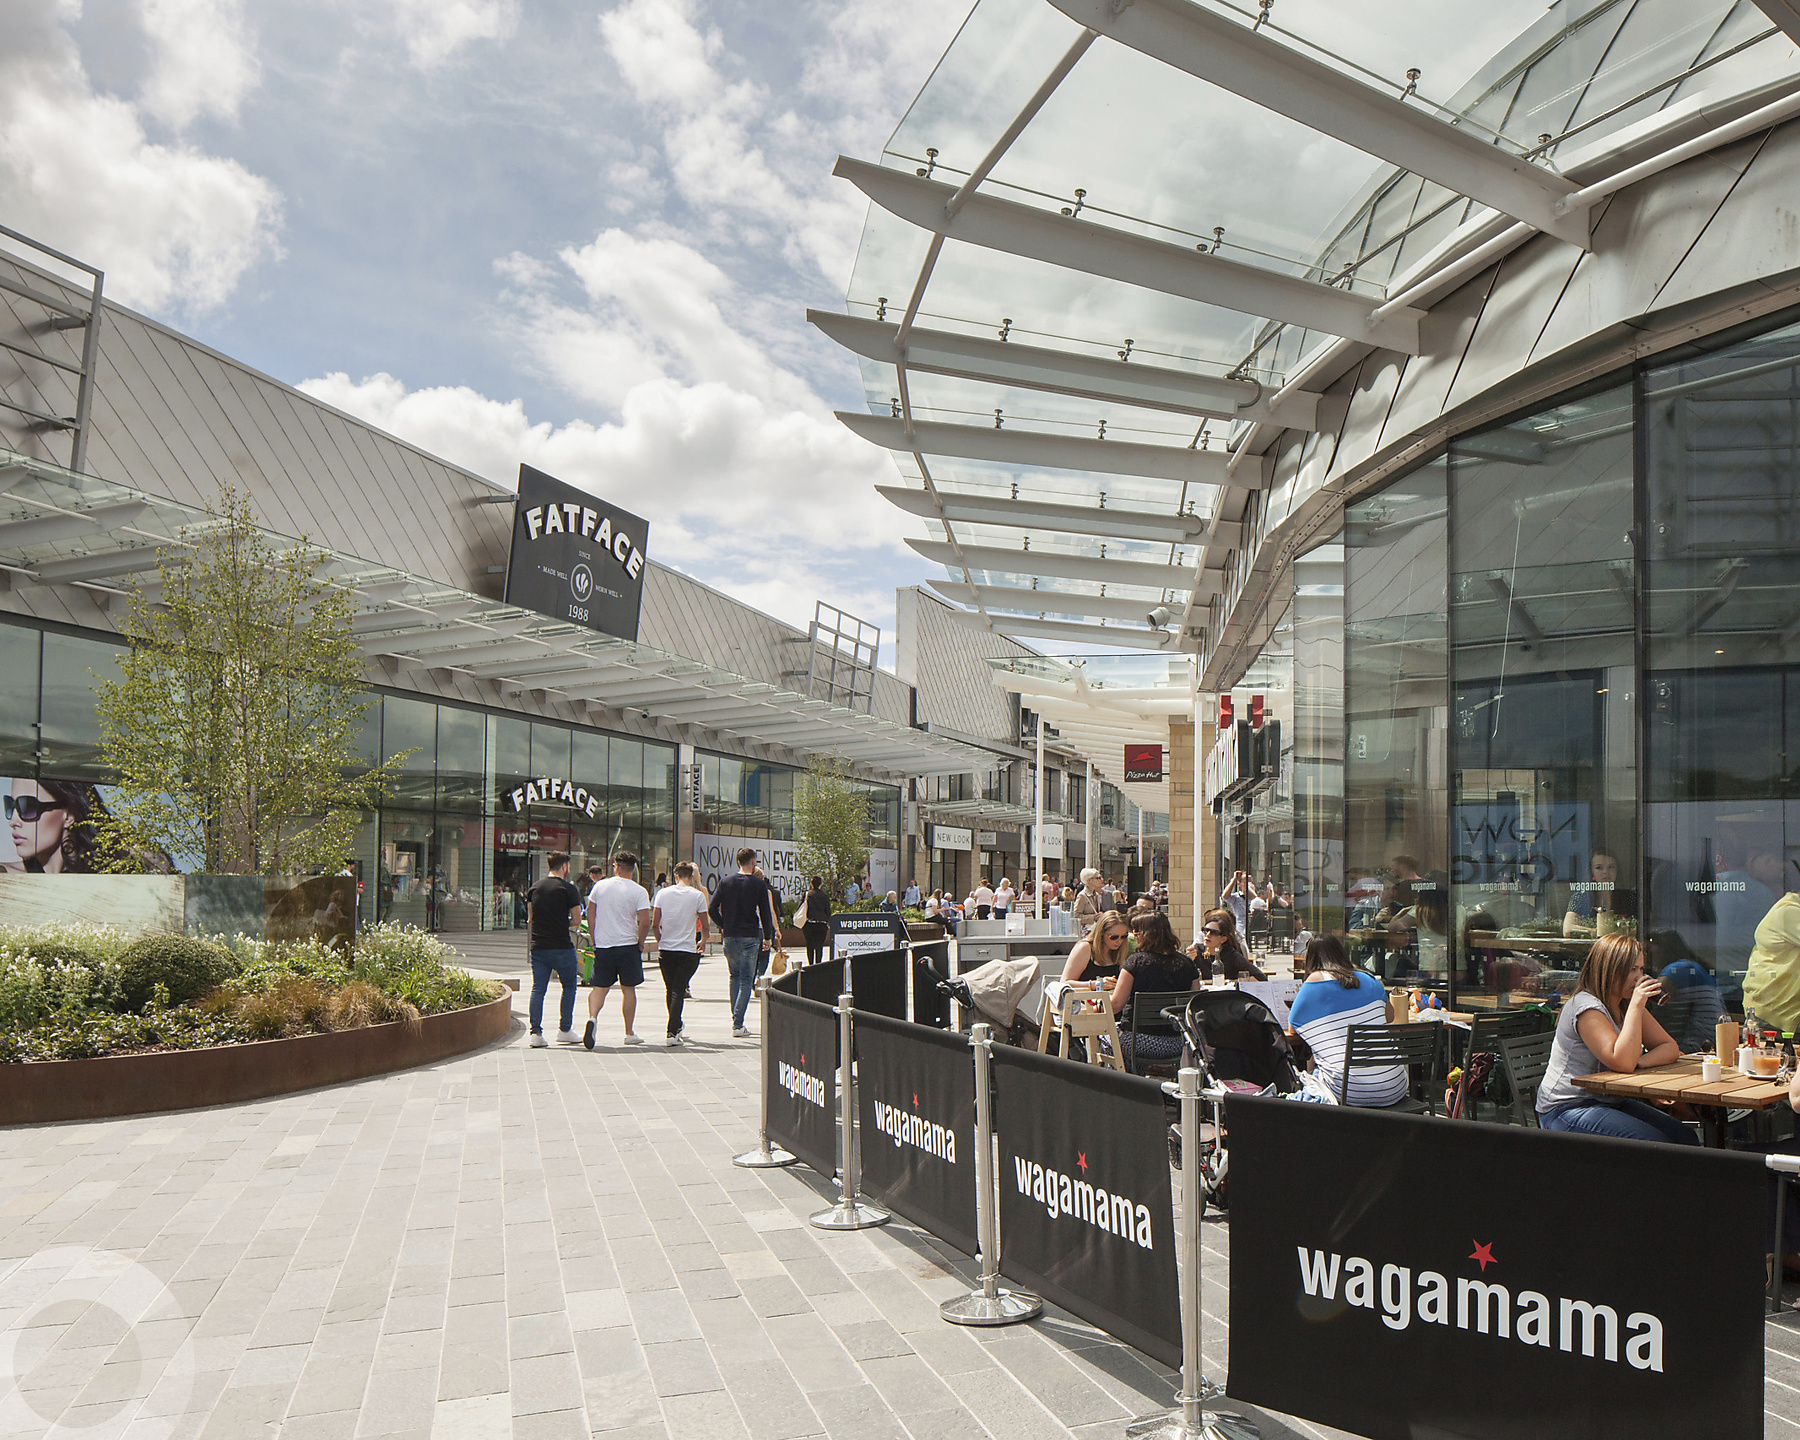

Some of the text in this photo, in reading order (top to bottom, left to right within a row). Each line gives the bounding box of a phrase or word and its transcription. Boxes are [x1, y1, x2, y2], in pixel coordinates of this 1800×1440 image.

[525, 503, 644, 580] FATFACE
[568, 604, 589, 621] 1988
[1126, 771, 1160, 779] Pizza Hut
[511, 778, 599, 819] FATFACE
[937, 833, 971, 844] NEW LOOK
[1048, 837, 1062, 846] LOOK
[700, 845, 735, 868] NOW
[1410, 882, 1437, 892] wagamama
[1480, 882, 1519, 892] wagamama
[1570, 881, 1615, 893] wagamama
[1685, 881, 1746, 894] wagamama
[840, 920, 889, 930] wagamama
[778, 1059, 825, 1109] wagamama
[874, 1099, 957, 1165] wagamama
[1014, 1155, 1154, 1251] wagamama
[1297, 1246, 1665, 1374] wagamama
